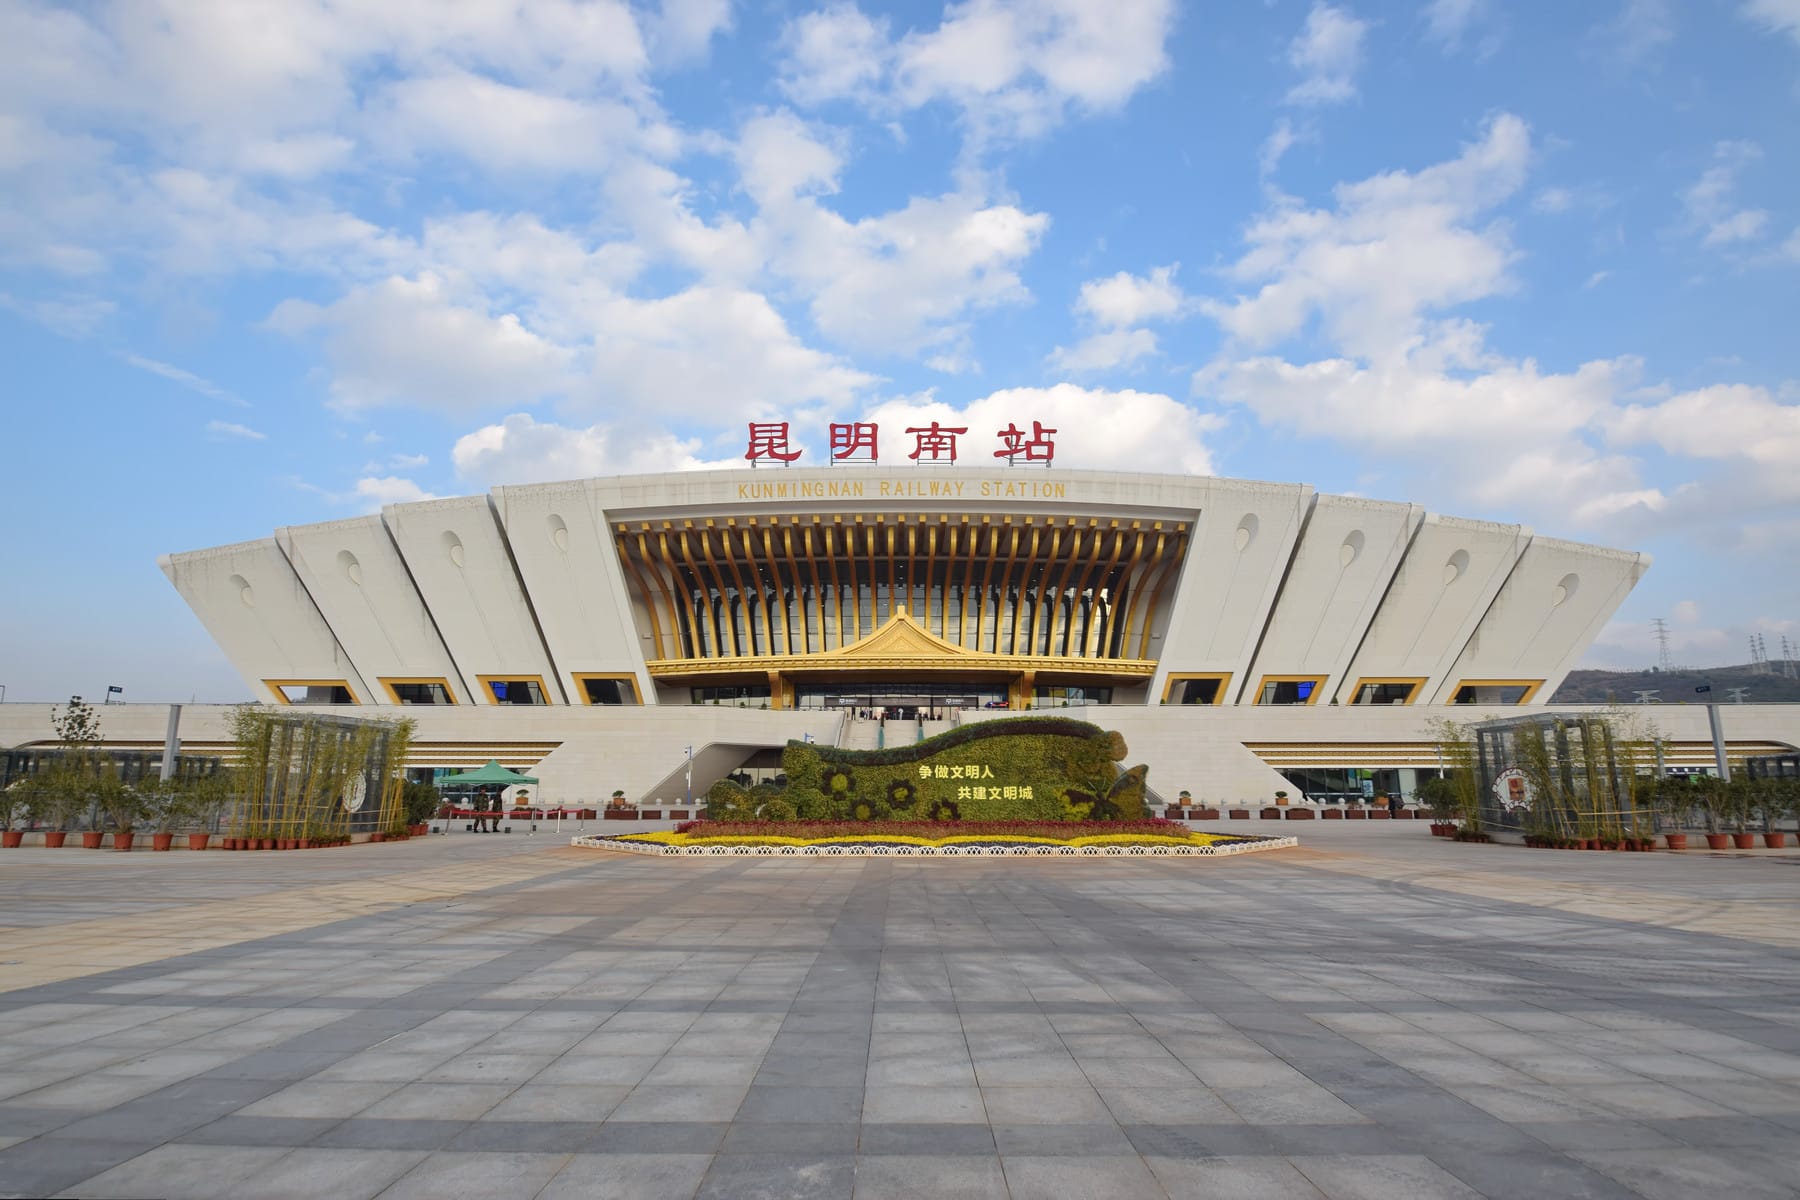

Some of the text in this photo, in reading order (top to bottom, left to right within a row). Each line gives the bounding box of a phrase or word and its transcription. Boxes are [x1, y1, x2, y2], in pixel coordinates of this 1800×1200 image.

[745, 421, 1057, 460] 昆明南站
[738, 481, 1066, 498] KUNMINGNAN RAILWAY STATION
[918, 765, 994, 779] 争做文明人
[958, 786, 1034, 800] 共建文明城
